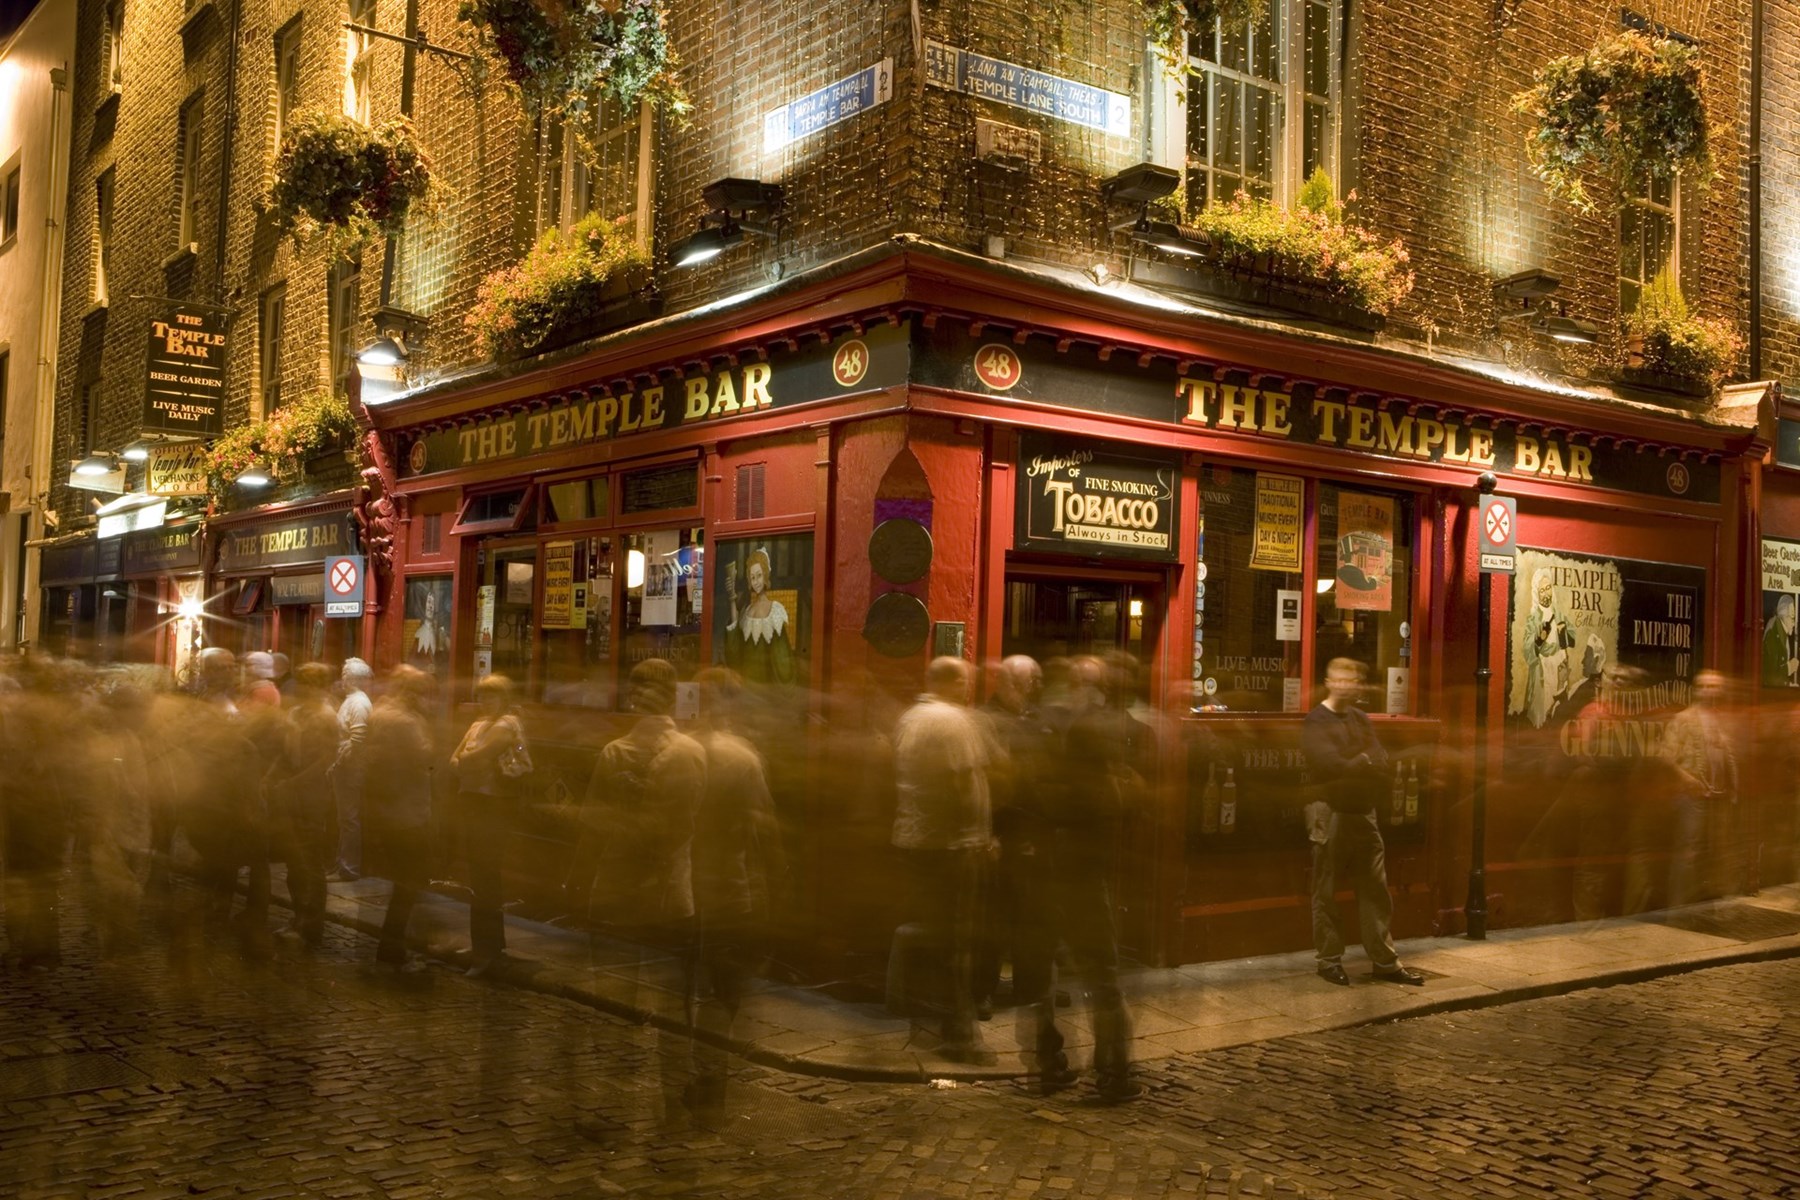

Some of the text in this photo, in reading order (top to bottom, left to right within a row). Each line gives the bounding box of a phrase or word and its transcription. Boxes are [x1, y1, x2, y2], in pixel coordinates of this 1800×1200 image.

[968, 76, 1103, 125] TEMPLE LANE SOUTH
[800, 106, 836, 132] TEMPLE
[1115, 106, 1125, 124] 2
[176, 314, 203, 326] THE
[151, 321, 226, 346] TEMPLE
[166, 339, 209, 358] BAR
[838, 348, 865, 378] 48
[983, 350, 1011, 379] 48
[150, 371, 222, 387] BEER GARDEN
[153, 401, 215, 415] LIVE MUSIC
[168, 411, 201, 421] DAILY
[459, 362, 773, 462] THE TEMPLE BAR
[1178, 377, 1594, 482] THE TEMPLE BAR
[154, 444, 197, 455] OFFICIAL
[152, 452, 200, 474] Temple Bar
[1026, 449, 1093, 480] Importers
[154, 472, 201, 484] MERCHANDISE
[1068, 468, 1081, 478] OF
[154, 484, 201, 493] STORE
[1084, 477, 1159, 497] FINE SMOKING
[1043, 479, 1159, 532] TOBACCO
[1259, 493, 1297, 508] TRADITIONAL
[1259, 512, 1297, 526] MUSIC EVERY
[1341, 503, 1372, 520] TEMPLE
[175, 533, 190, 547] BAR
[235, 536, 257, 556] THE
[260, 528, 308, 554] TEMPLE
[312, 524, 339, 547] BAR
[1067, 525, 1167, 546] Always in Stock
[1260, 529, 1271, 542] DAY
[1277, 531, 1295, 544] NIGHT
[1763, 544, 1800, 561] Beer Garde
[1763, 559, 1790, 578] Smoking
[1550, 566, 1619, 592] TEMPLE
[1768, 575, 1783, 590] Area
[1571, 590, 1603, 614] BAR
[1667, 593, 1692, 619] THE
[1633, 619, 1691, 649] EMPEROR
[632, 648, 686, 662] LIVE MUSIC
[1216, 656, 1288, 672] LIVE MUSIC
[1676, 653, 1689, 677] OF
[1234, 676, 1271, 690] DAILY
[1560, 718, 1680, 757] GUINNE
